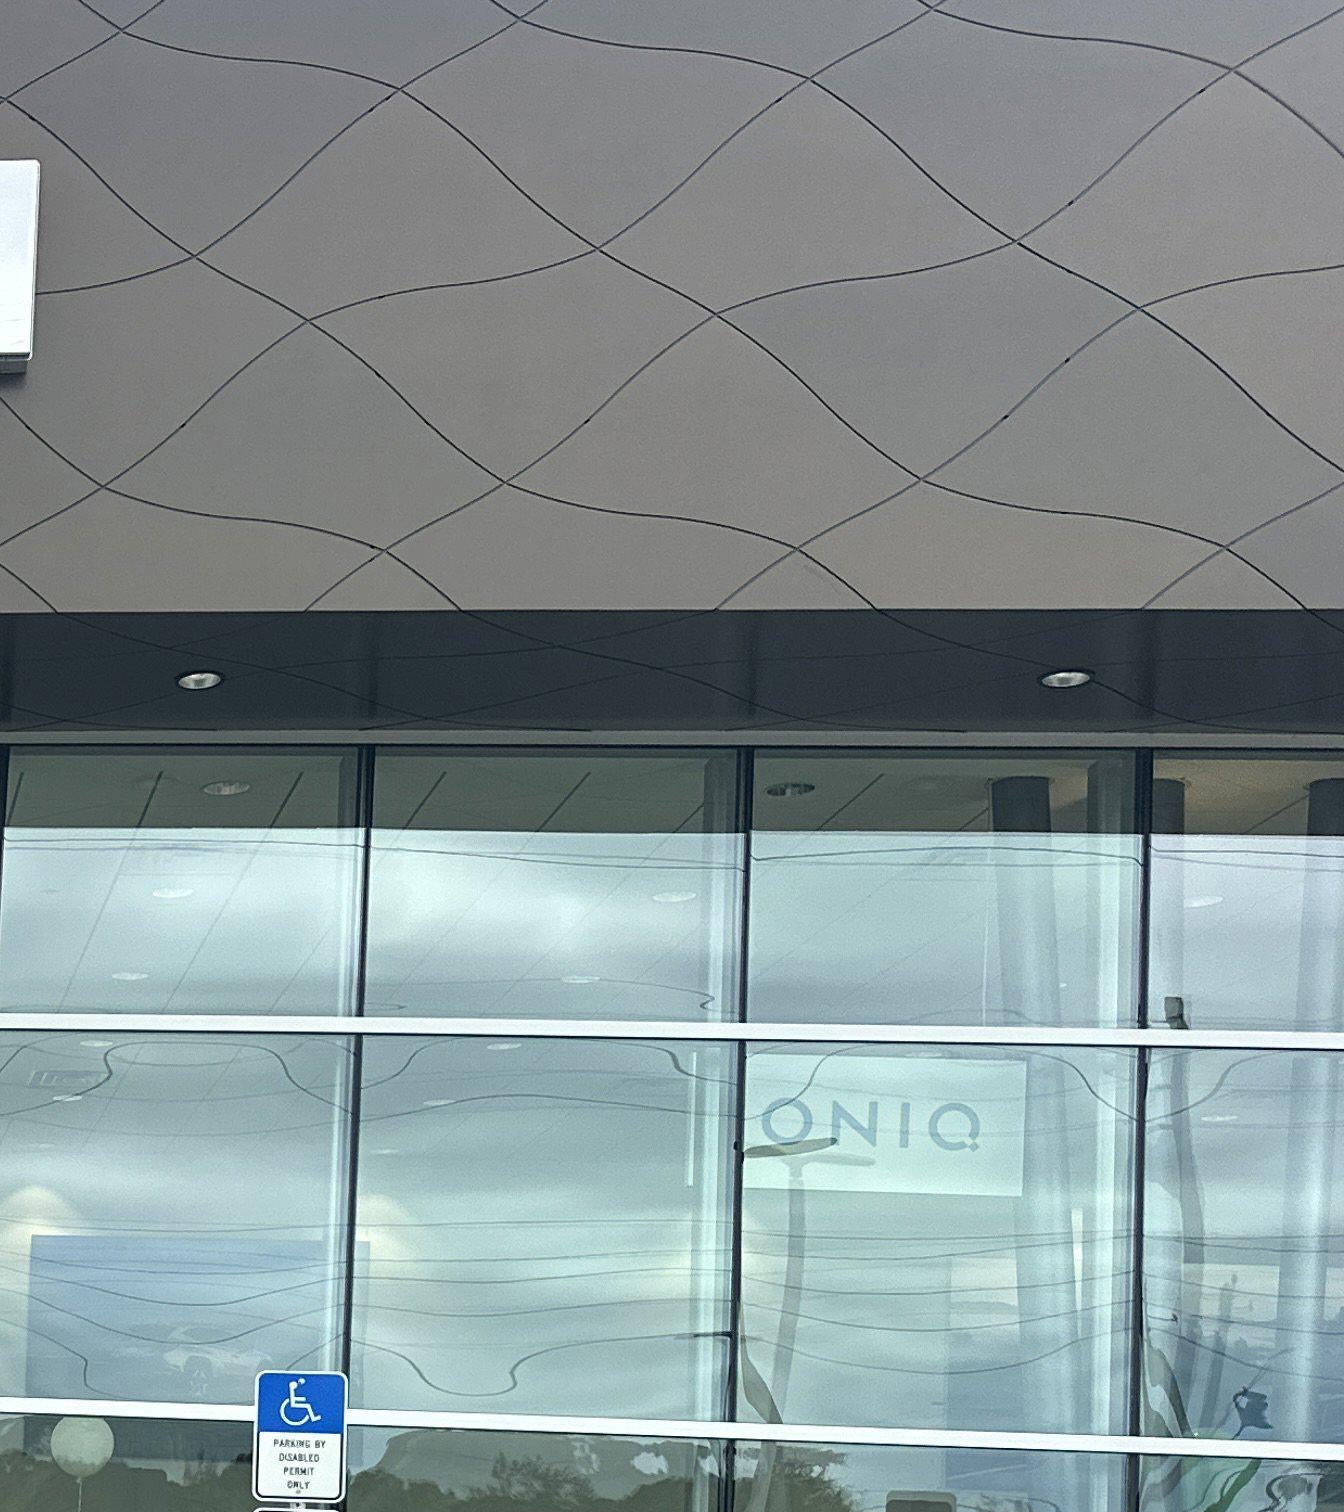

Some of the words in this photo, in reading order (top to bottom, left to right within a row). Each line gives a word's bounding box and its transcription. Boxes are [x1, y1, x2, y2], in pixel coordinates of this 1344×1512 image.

[762, 1097, 980, 1152] ONIQ
[273, 1439, 311, 1449] PARKING
[314, 1440, 326, 1449] BY
[278, 1453, 320, 1463] DISABLED
[283, 1467, 315, 1476] PERMIT
[287, 1480, 310, 1489] ONLY
